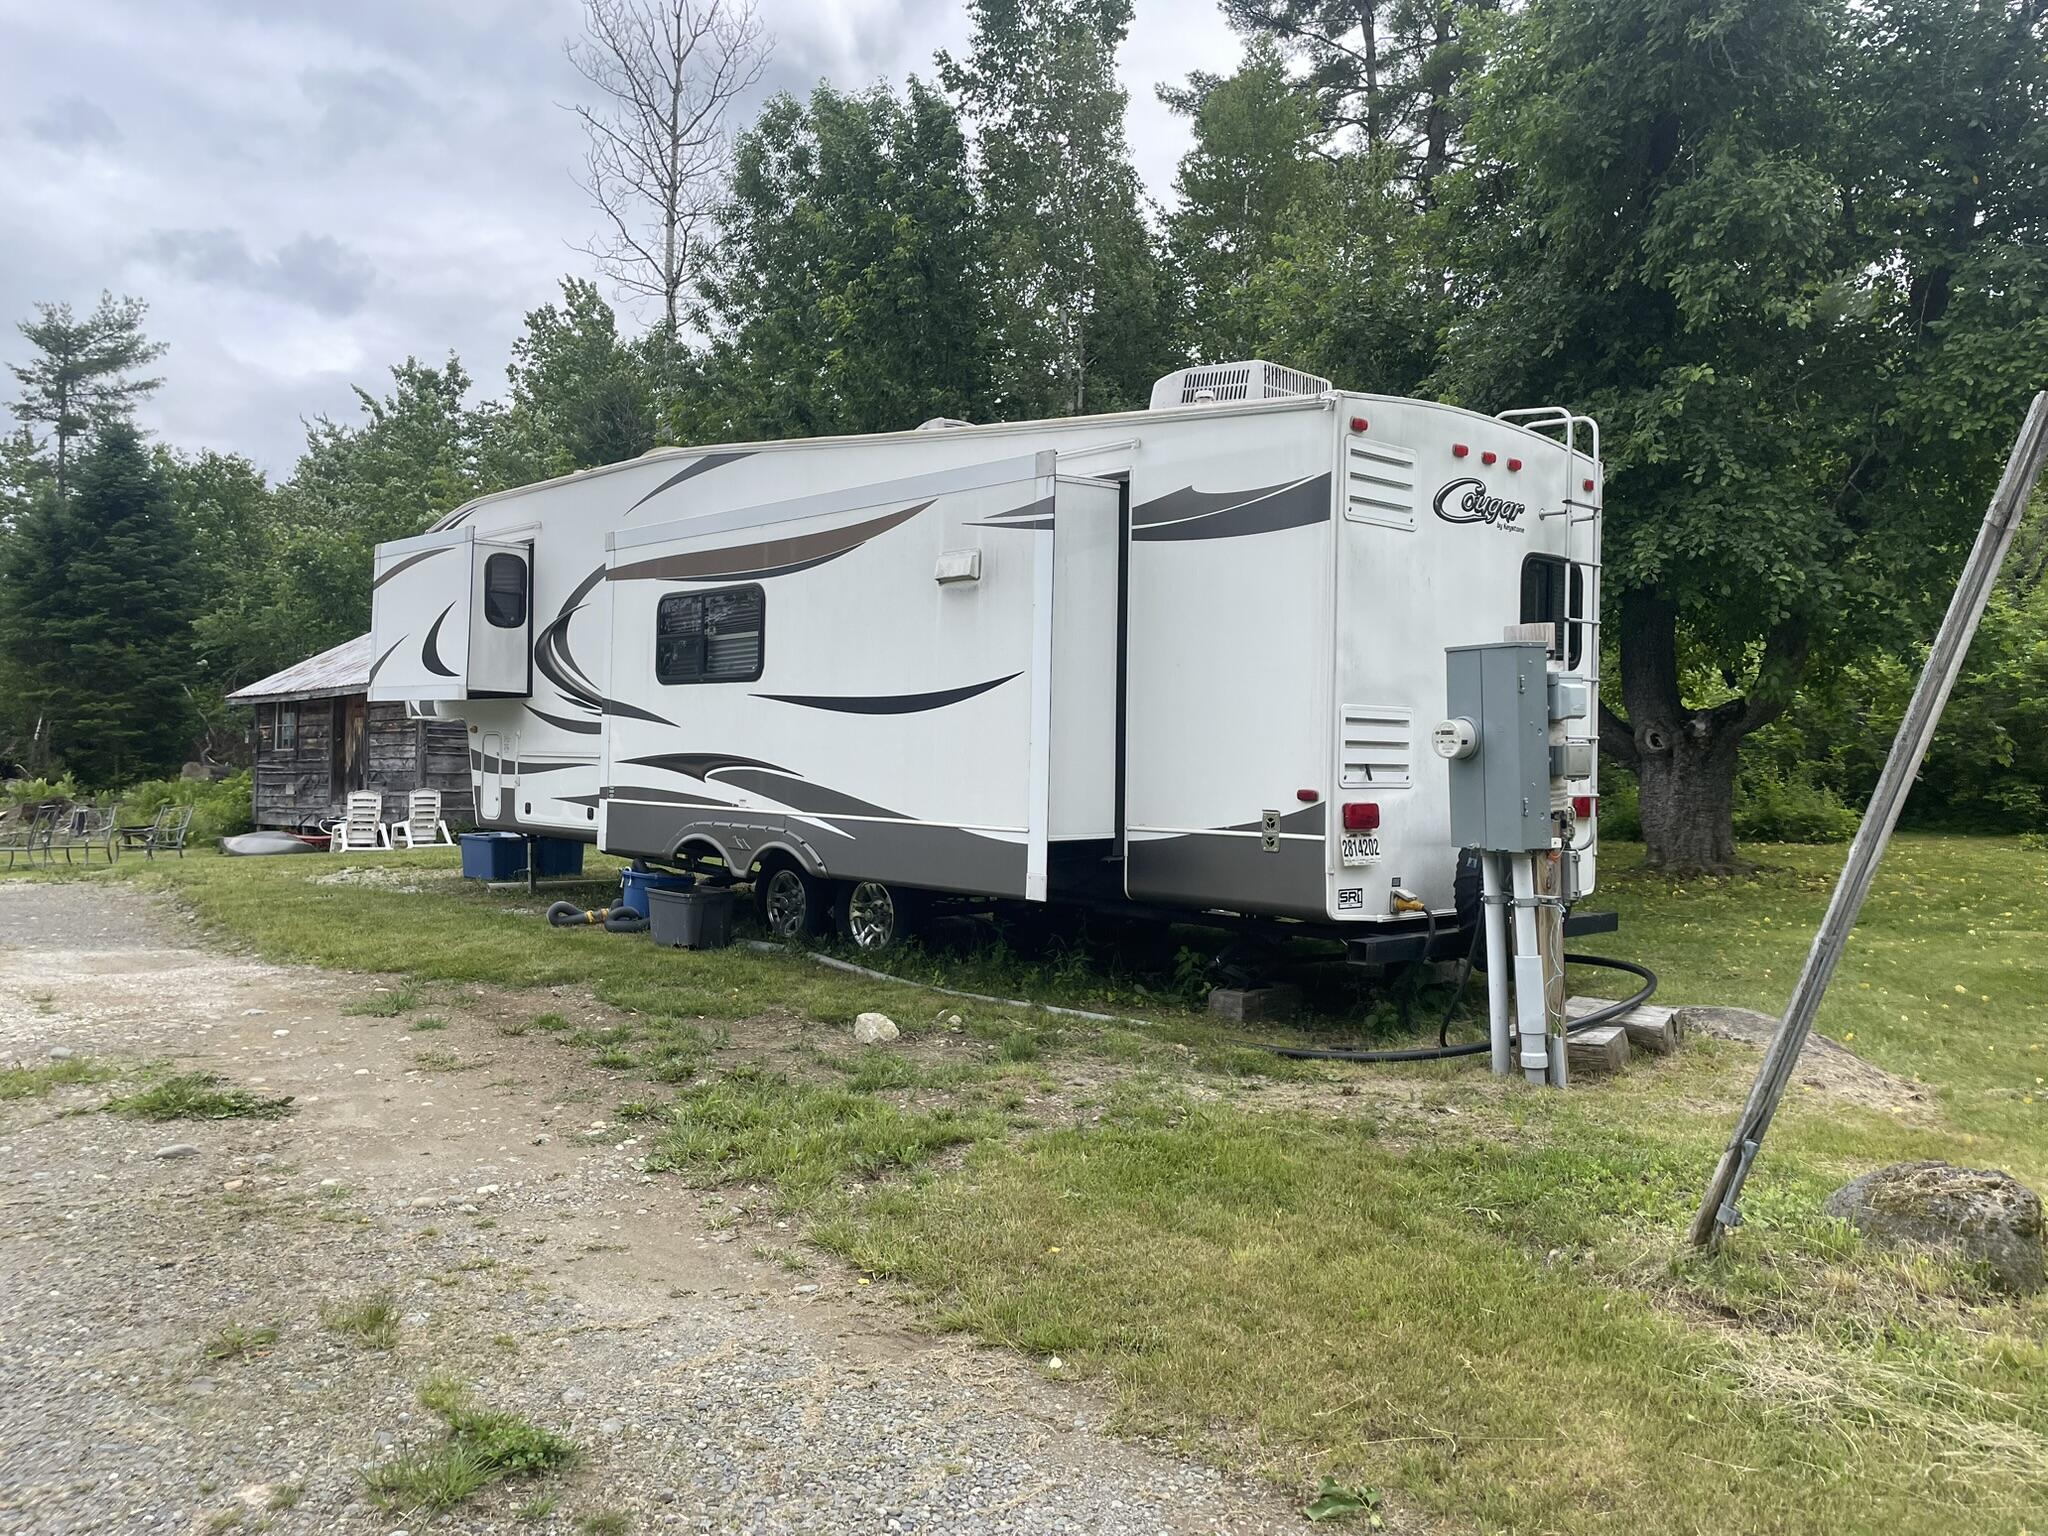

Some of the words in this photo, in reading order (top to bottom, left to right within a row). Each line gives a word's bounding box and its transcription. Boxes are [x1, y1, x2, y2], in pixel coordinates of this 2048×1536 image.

[1433, 477, 1525, 525] Cougar
[1497, 521, 1503, 531] by
[1503, 523, 1525, 533] Keystone
[1342, 838, 1380, 857] 2814202
